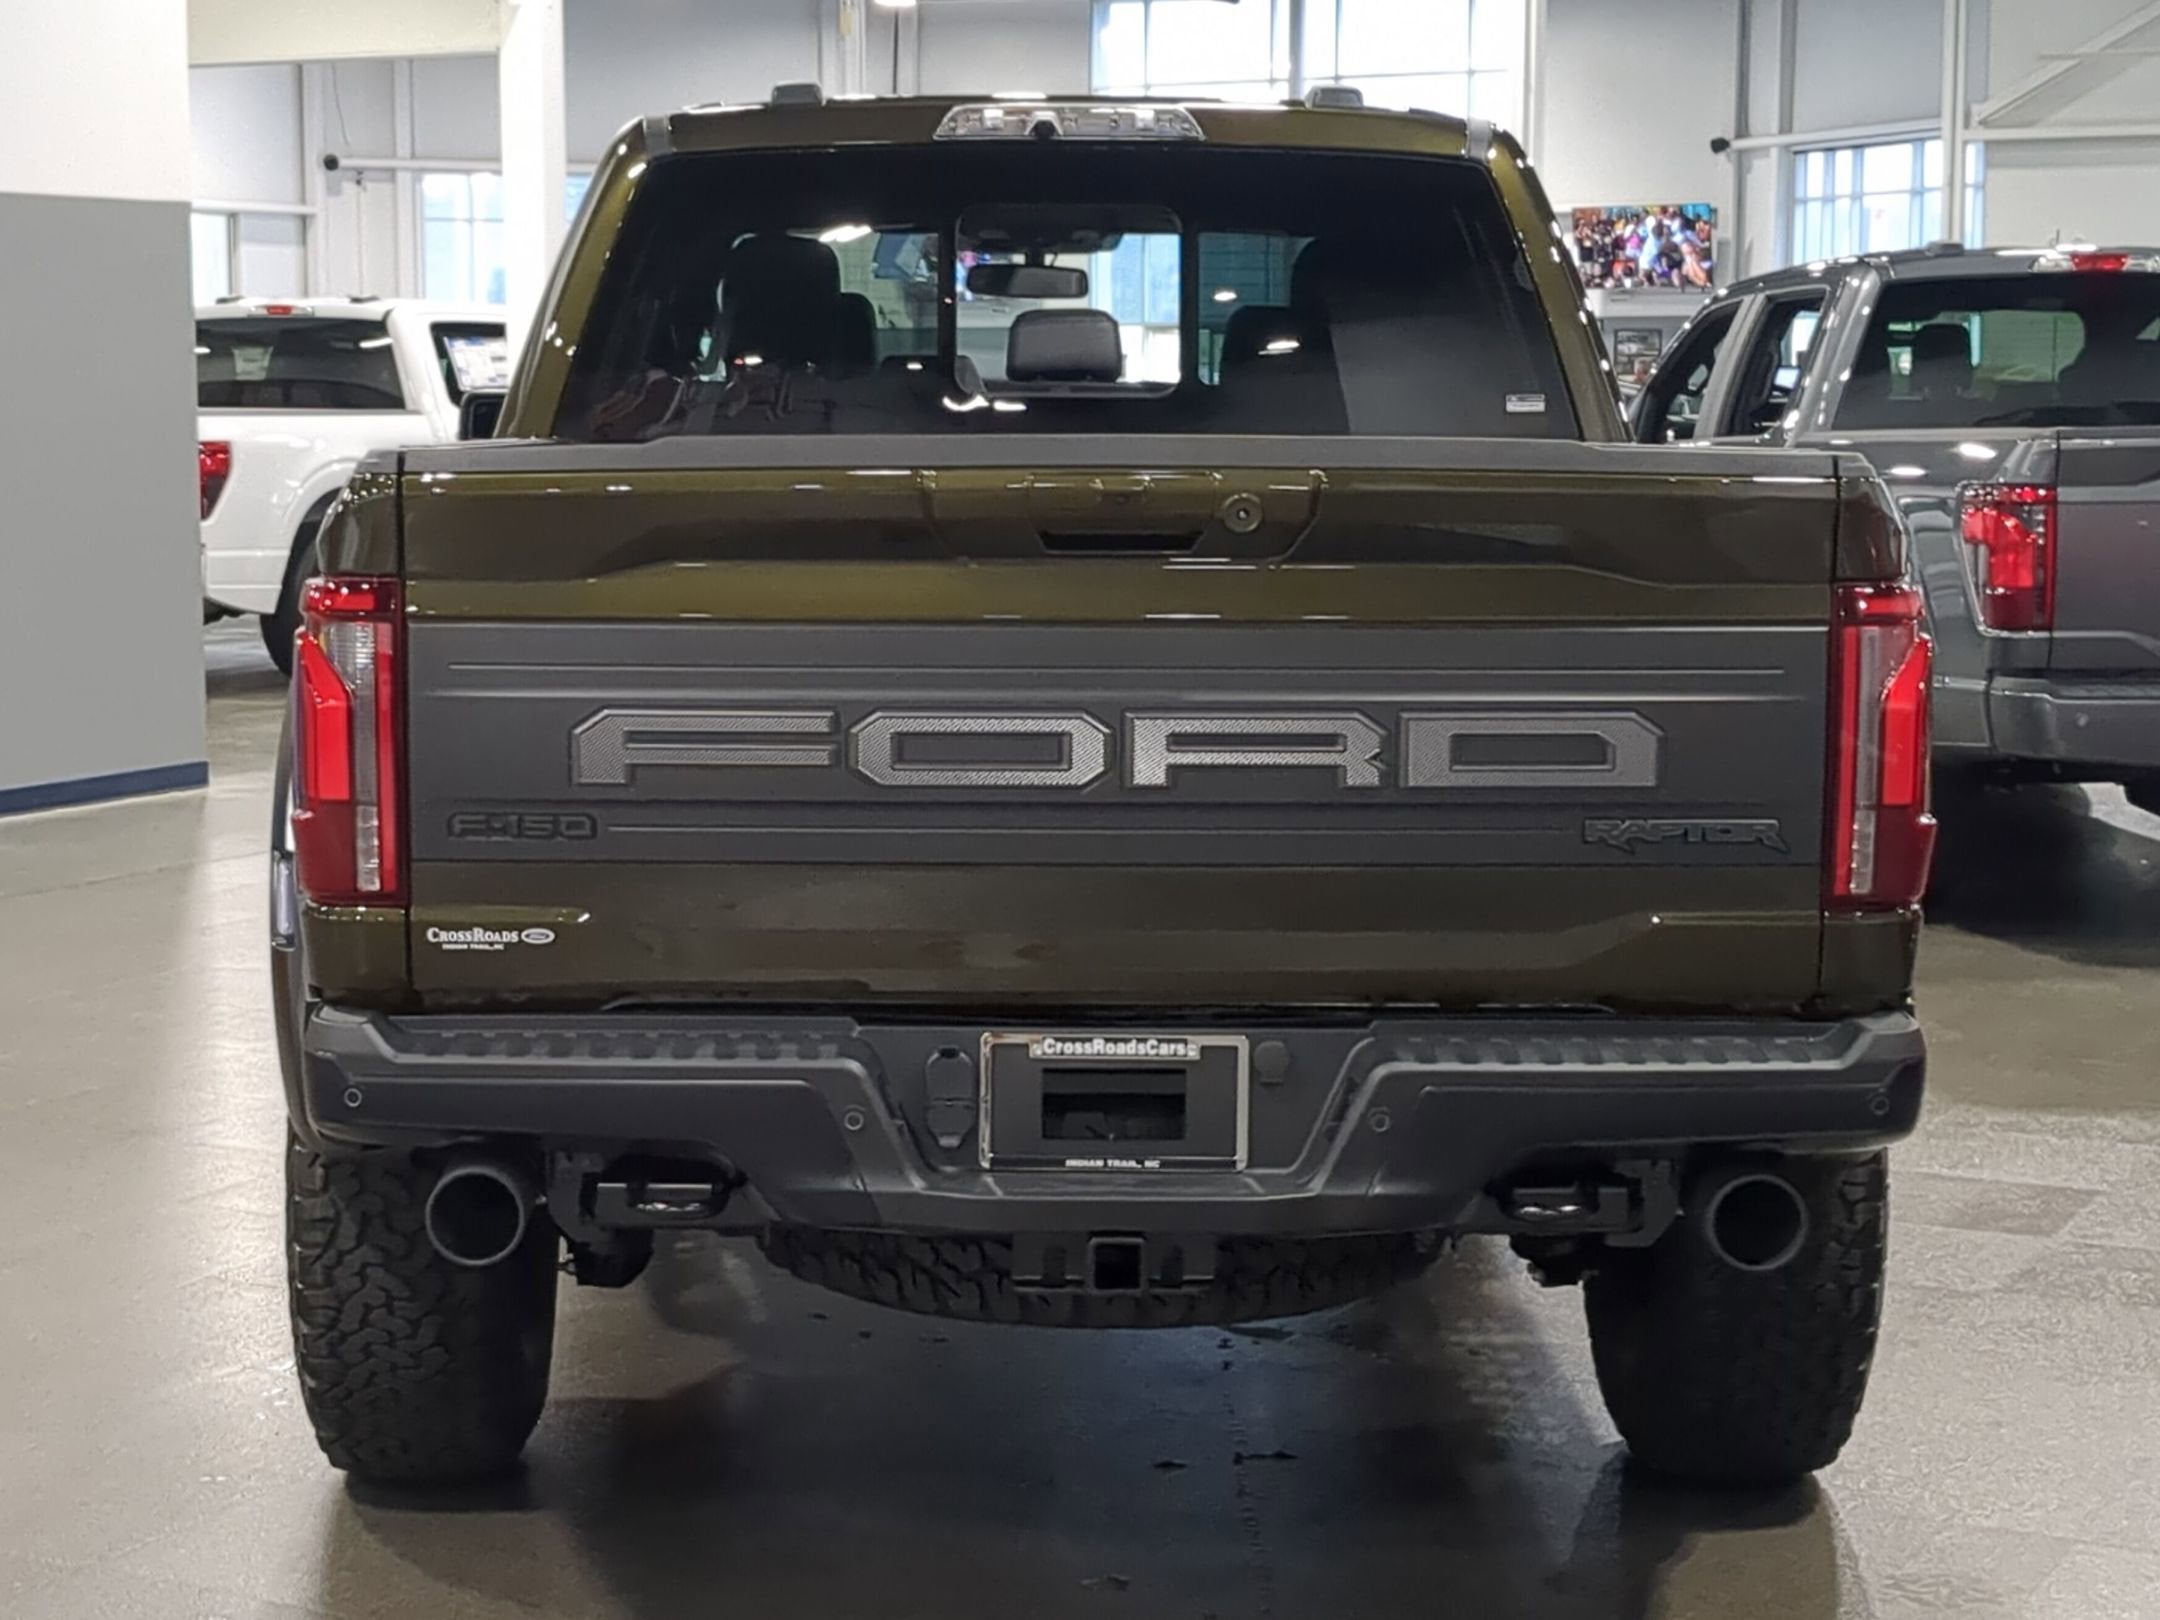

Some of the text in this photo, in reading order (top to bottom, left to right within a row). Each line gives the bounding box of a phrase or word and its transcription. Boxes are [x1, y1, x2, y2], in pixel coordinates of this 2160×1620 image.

[571, 707, 1664, 788] FORD
[450, 813, 597, 838] F-150
[1583, 818, 1790, 854] RAPTOR
[1043, 1038, 1186, 1055] CrossRoadsCars
